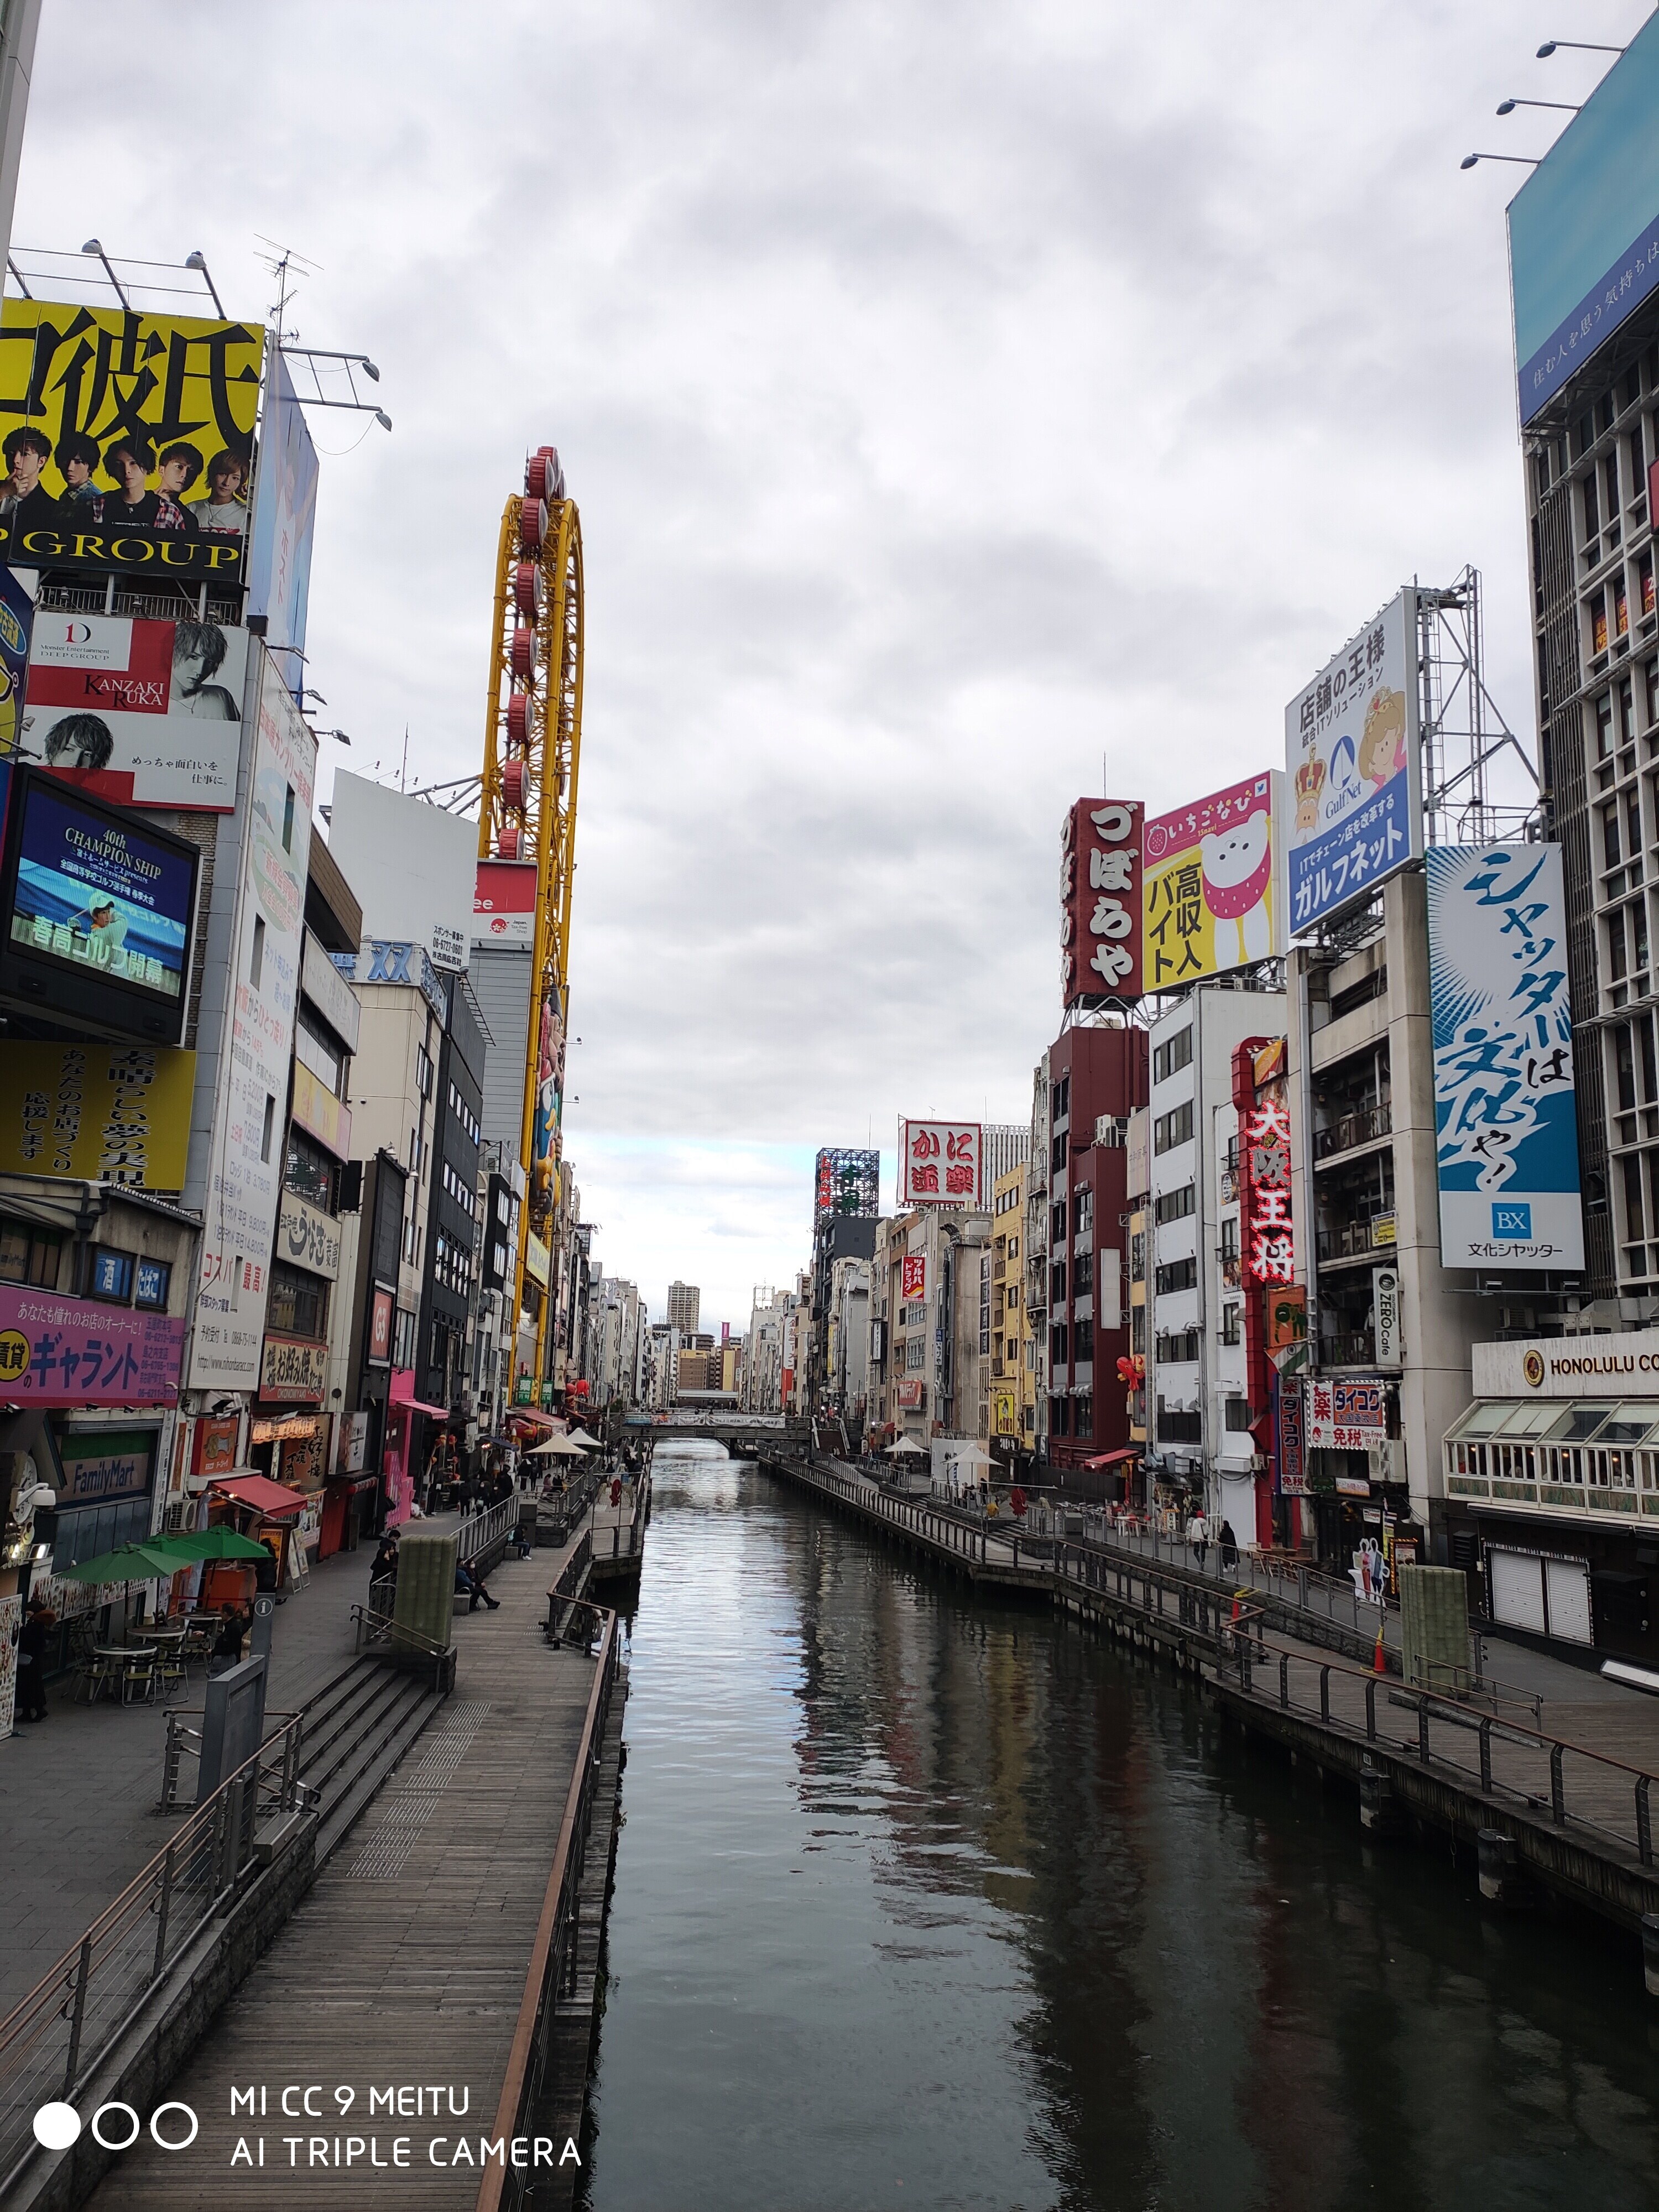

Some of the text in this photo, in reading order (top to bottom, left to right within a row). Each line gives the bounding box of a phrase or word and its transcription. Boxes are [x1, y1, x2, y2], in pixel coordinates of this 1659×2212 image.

[23, 531, 239, 569] GROUP
[67, 646, 109, 655] Entertainment
[85, 674, 164, 696] KANZAKI
[1299, 623, 1385, 735] 店舗の王様
[113, 691, 163, 708] RUKA
[1301, 666, 1384, 749] 統合ITソリューション
[132, 757, 218, 771] めっちゃ面白いを
[192, 773, 228, 787] 仕事に。
[1168, 789, 1253, 839] いちごなび
[102, 828, 127, 849] 40th
[1299, 792, 1395, 875] ITでチェーン店を改革する
[65, 827, 134, 868] CHAMPION
[135, 860, 162, 880] SHIP
[1295, 816, 1402, 921] ガルフネット
[1090, 802, 1139, 987] づぼらや
[433, 925, 465, 943] スポンサー募集中
[1148, 870, 1175, 984] バイト
[1175, 861, 1203, 977] 高収入
[32, 915, 164, 984] 春高ゴルフ開幕
[432, 938, 463, 956] 06-6727-0601
[1462, 851, 1572, 1089] シャッターは
[18, 1092, 51, 1161] 応援します
[52, 1049, 86, 1171] あなたのお店づくり
[96, 1050, 157, 1188] 素晴らしい夢の実現
[911, 1129, 974, 1161] かに
[1245, 1100, 1294, 1283] 大阪王将
[288, 1206, 326, 1266] うなぎ
[1498, 1212, 1527, 1230] BX
[1467, 1243, 1563, 1259] 文化シャッター
[103, 1258, 116, 1291] 酒
[137, 1266, 159, 1298] たばこ
[204, 1253, 233, 1285] コスパ
[904, 1262, 913, 1291] ドラッグ
[912, 1259, 923, 1285] ツルハ
[18, 1302, 143, 1336] あなたも憧れのお店のオーナーに!
[1381, 1329, 1390, 1356] cafe
[29, 1332, 139, 1390] ギャラント
[276, 1344, 311, 1386] お好み焼
[1550, 1355, 1635, 1376] HONOLULU
[1639, 1354, 1659, 1372] CO
[277, 1387, 306, 1400] OKONOMIYAKI
[1313, 1385, 1332, 1422] 薬
[1335, 1387, 1380, 1411] ダイコク
[1281, 1398, 1300, 1448] ダイコク
[1333, 1427, 1362, 1447] 免税
[1361, 1430, 1383, 1438] Tax-Free
[73, 1459, 135, 1494] FamilyMart
[1281, 1475, 1303, 1486] 免税
